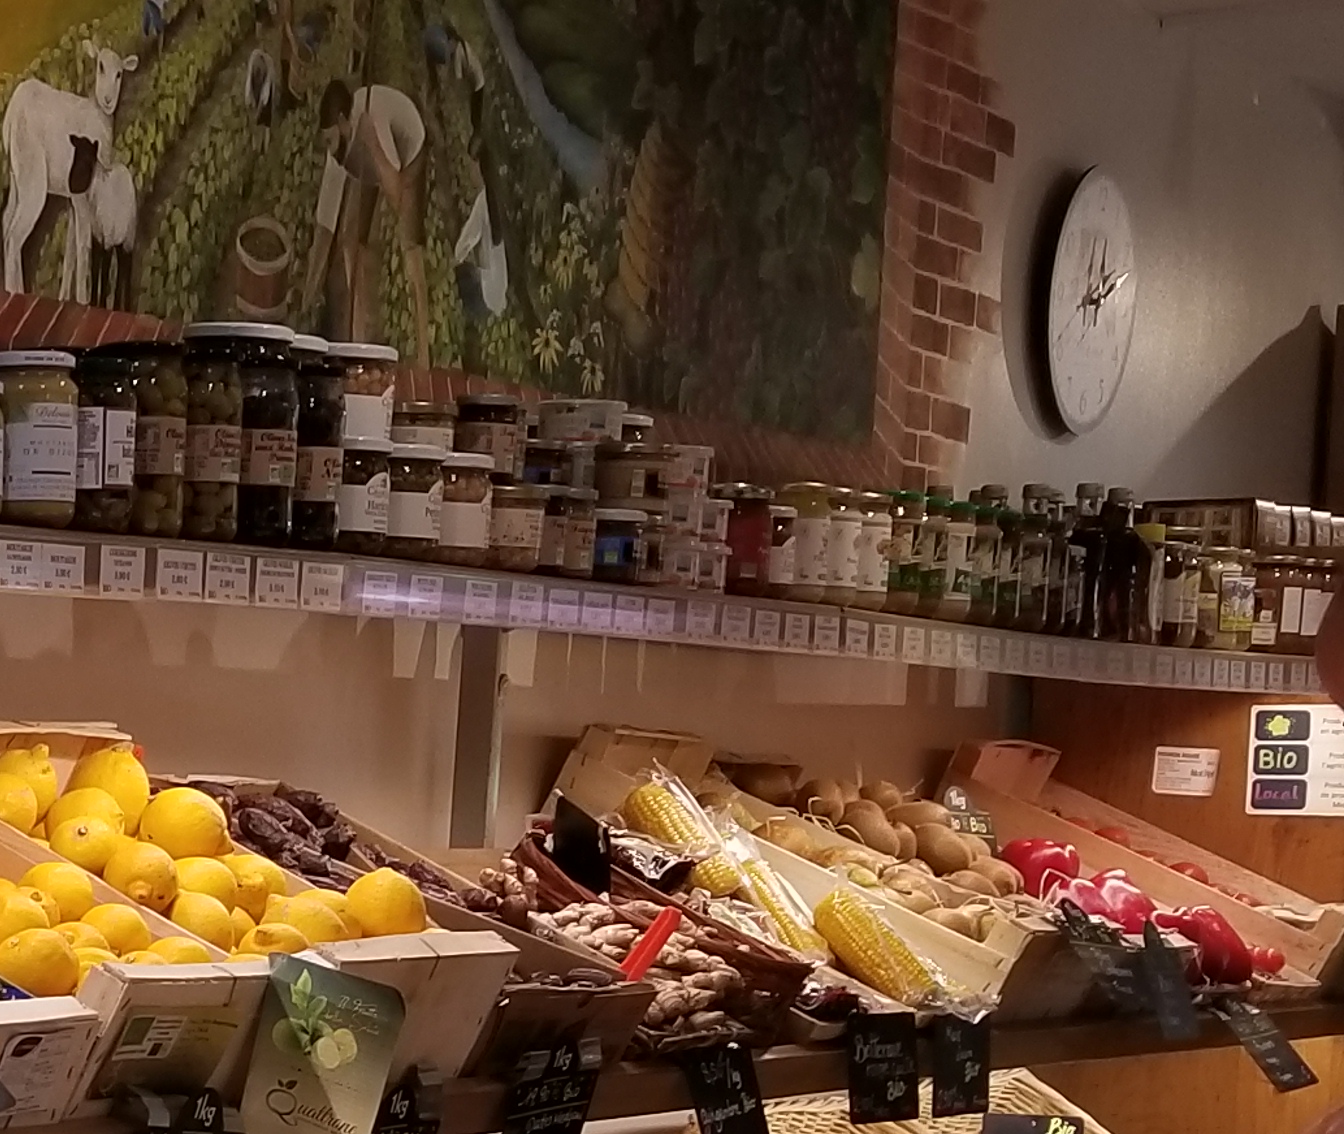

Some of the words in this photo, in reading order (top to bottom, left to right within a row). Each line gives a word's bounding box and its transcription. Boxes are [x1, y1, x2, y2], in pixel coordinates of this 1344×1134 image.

[1259, 747, 1297, 769] Bio
[552, 1042, 573, 1070] 1kg
[193, 1095, 216, 1128] 1kg
[389, 1089, 410, 1119] 1kg
